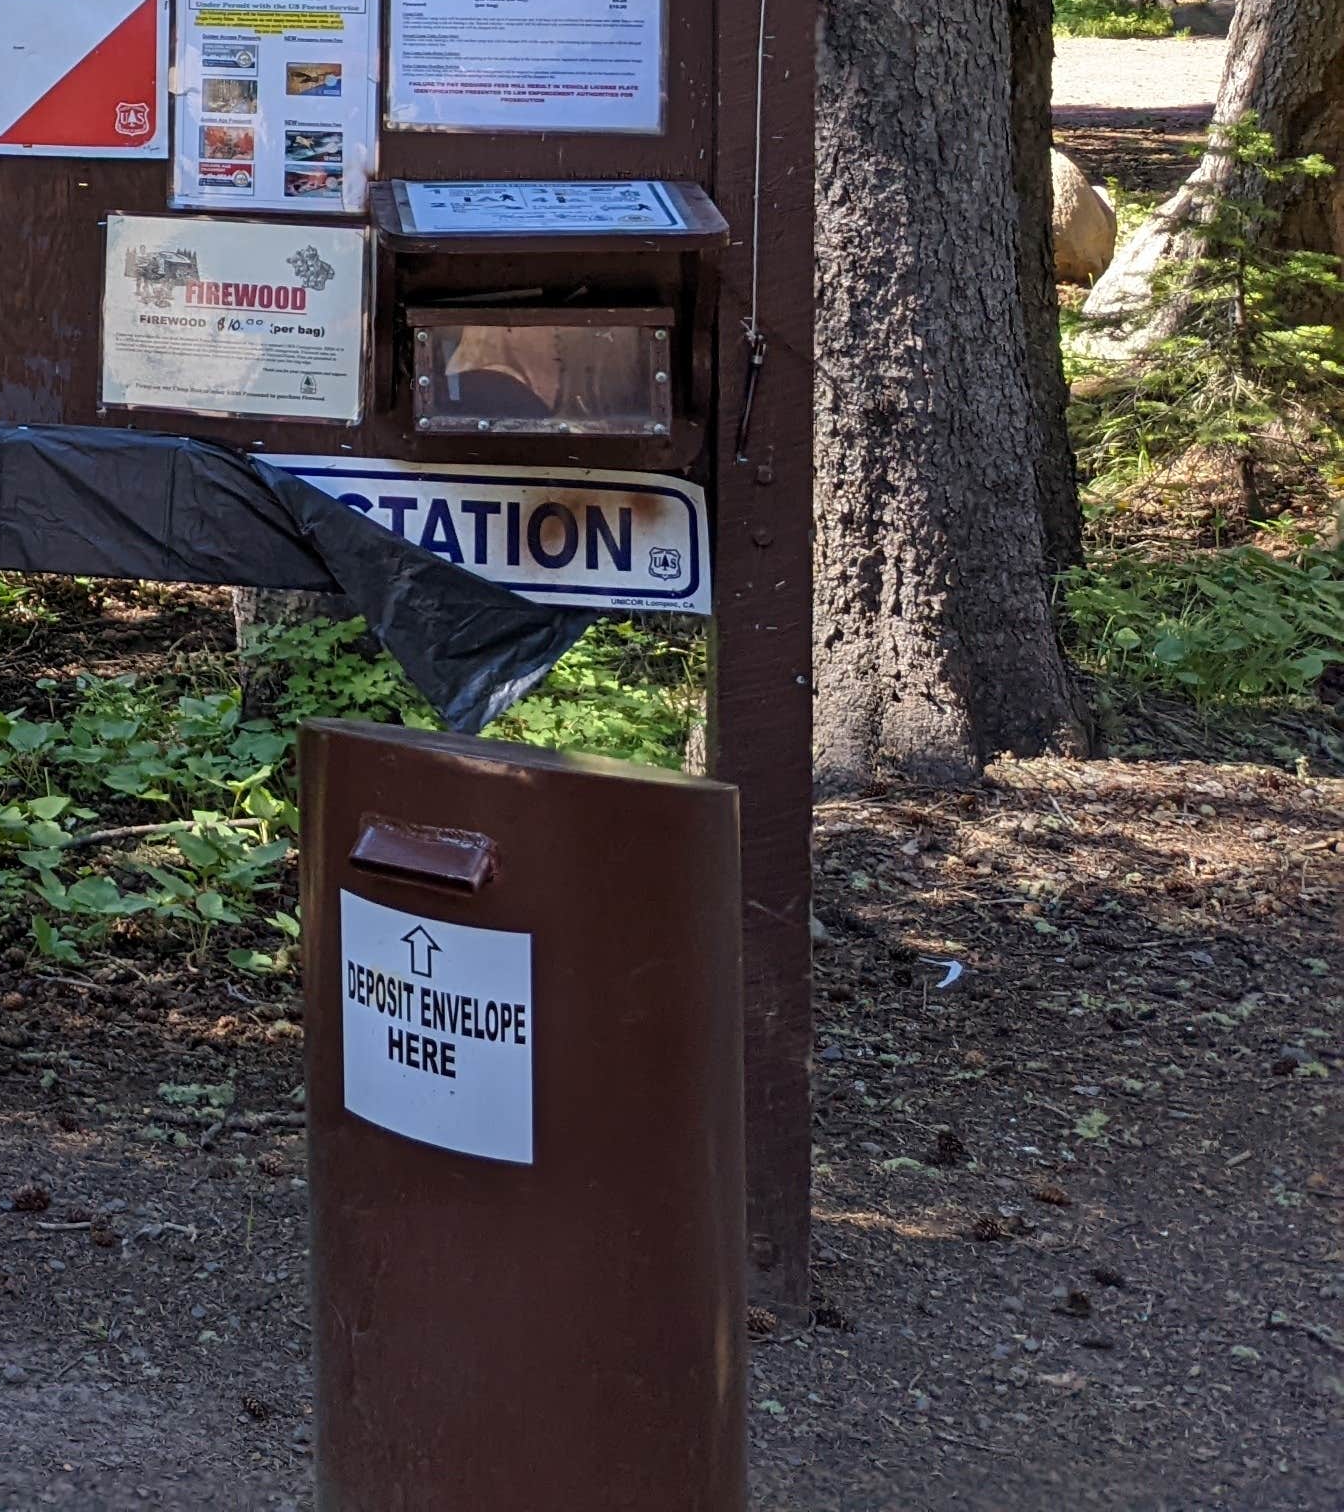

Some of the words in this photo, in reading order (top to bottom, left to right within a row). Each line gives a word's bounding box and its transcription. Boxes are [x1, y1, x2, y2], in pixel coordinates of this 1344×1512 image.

[185, 280, 306, 311] FIREWOOD
[140, 315, 206, 328] FIREWOOD
[270, 323, 295, 336] (per
[298, 325, 325, 338] bag)
[348, 960, 414, 1022] DEPOSIT
[421, 987, 526, 1045] ENVELOPE
[388, 1026, 456, 1079] HERE
